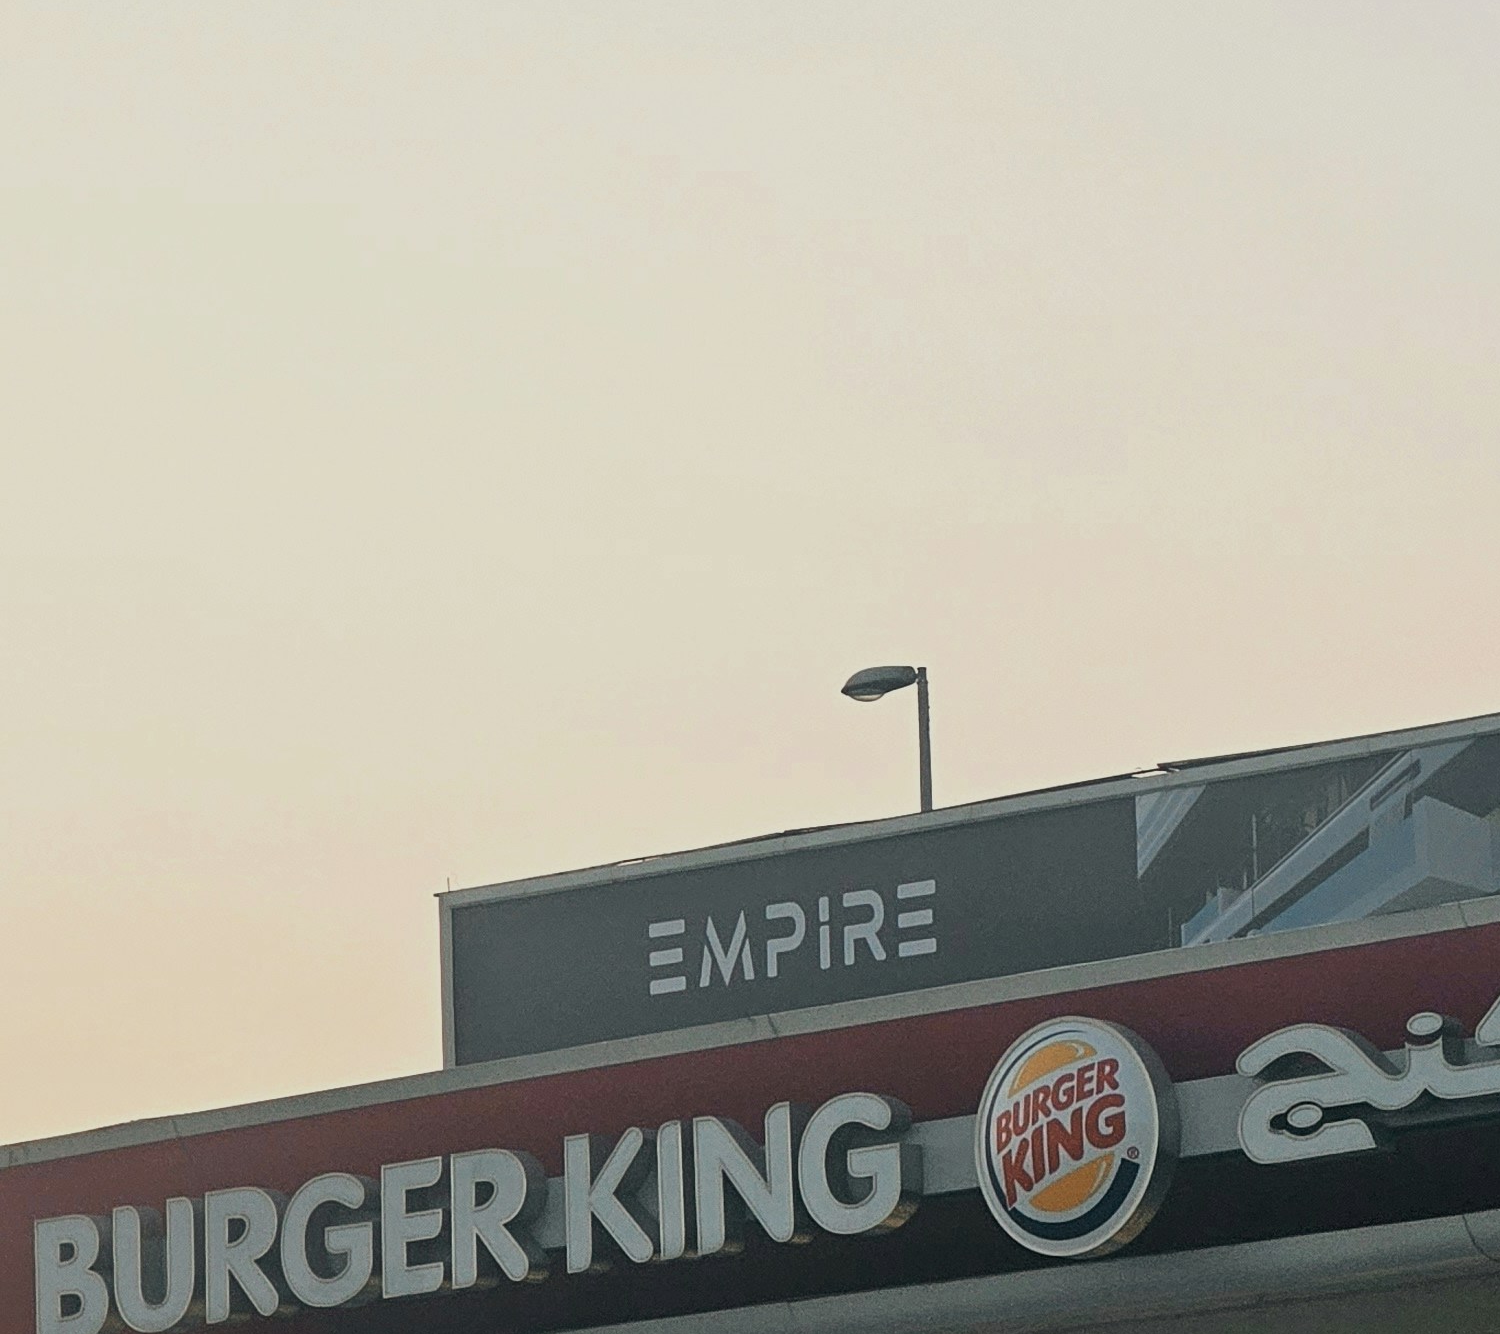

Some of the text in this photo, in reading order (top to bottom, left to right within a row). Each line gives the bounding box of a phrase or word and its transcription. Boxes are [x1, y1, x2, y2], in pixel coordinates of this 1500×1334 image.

[648, 879, 937, 995] EMPIRE
[996, 1058, 1120, 1155] BURGER
[1001, 1093, 1126, 1208] KING
[564, 1091, 902, 1274] KING
